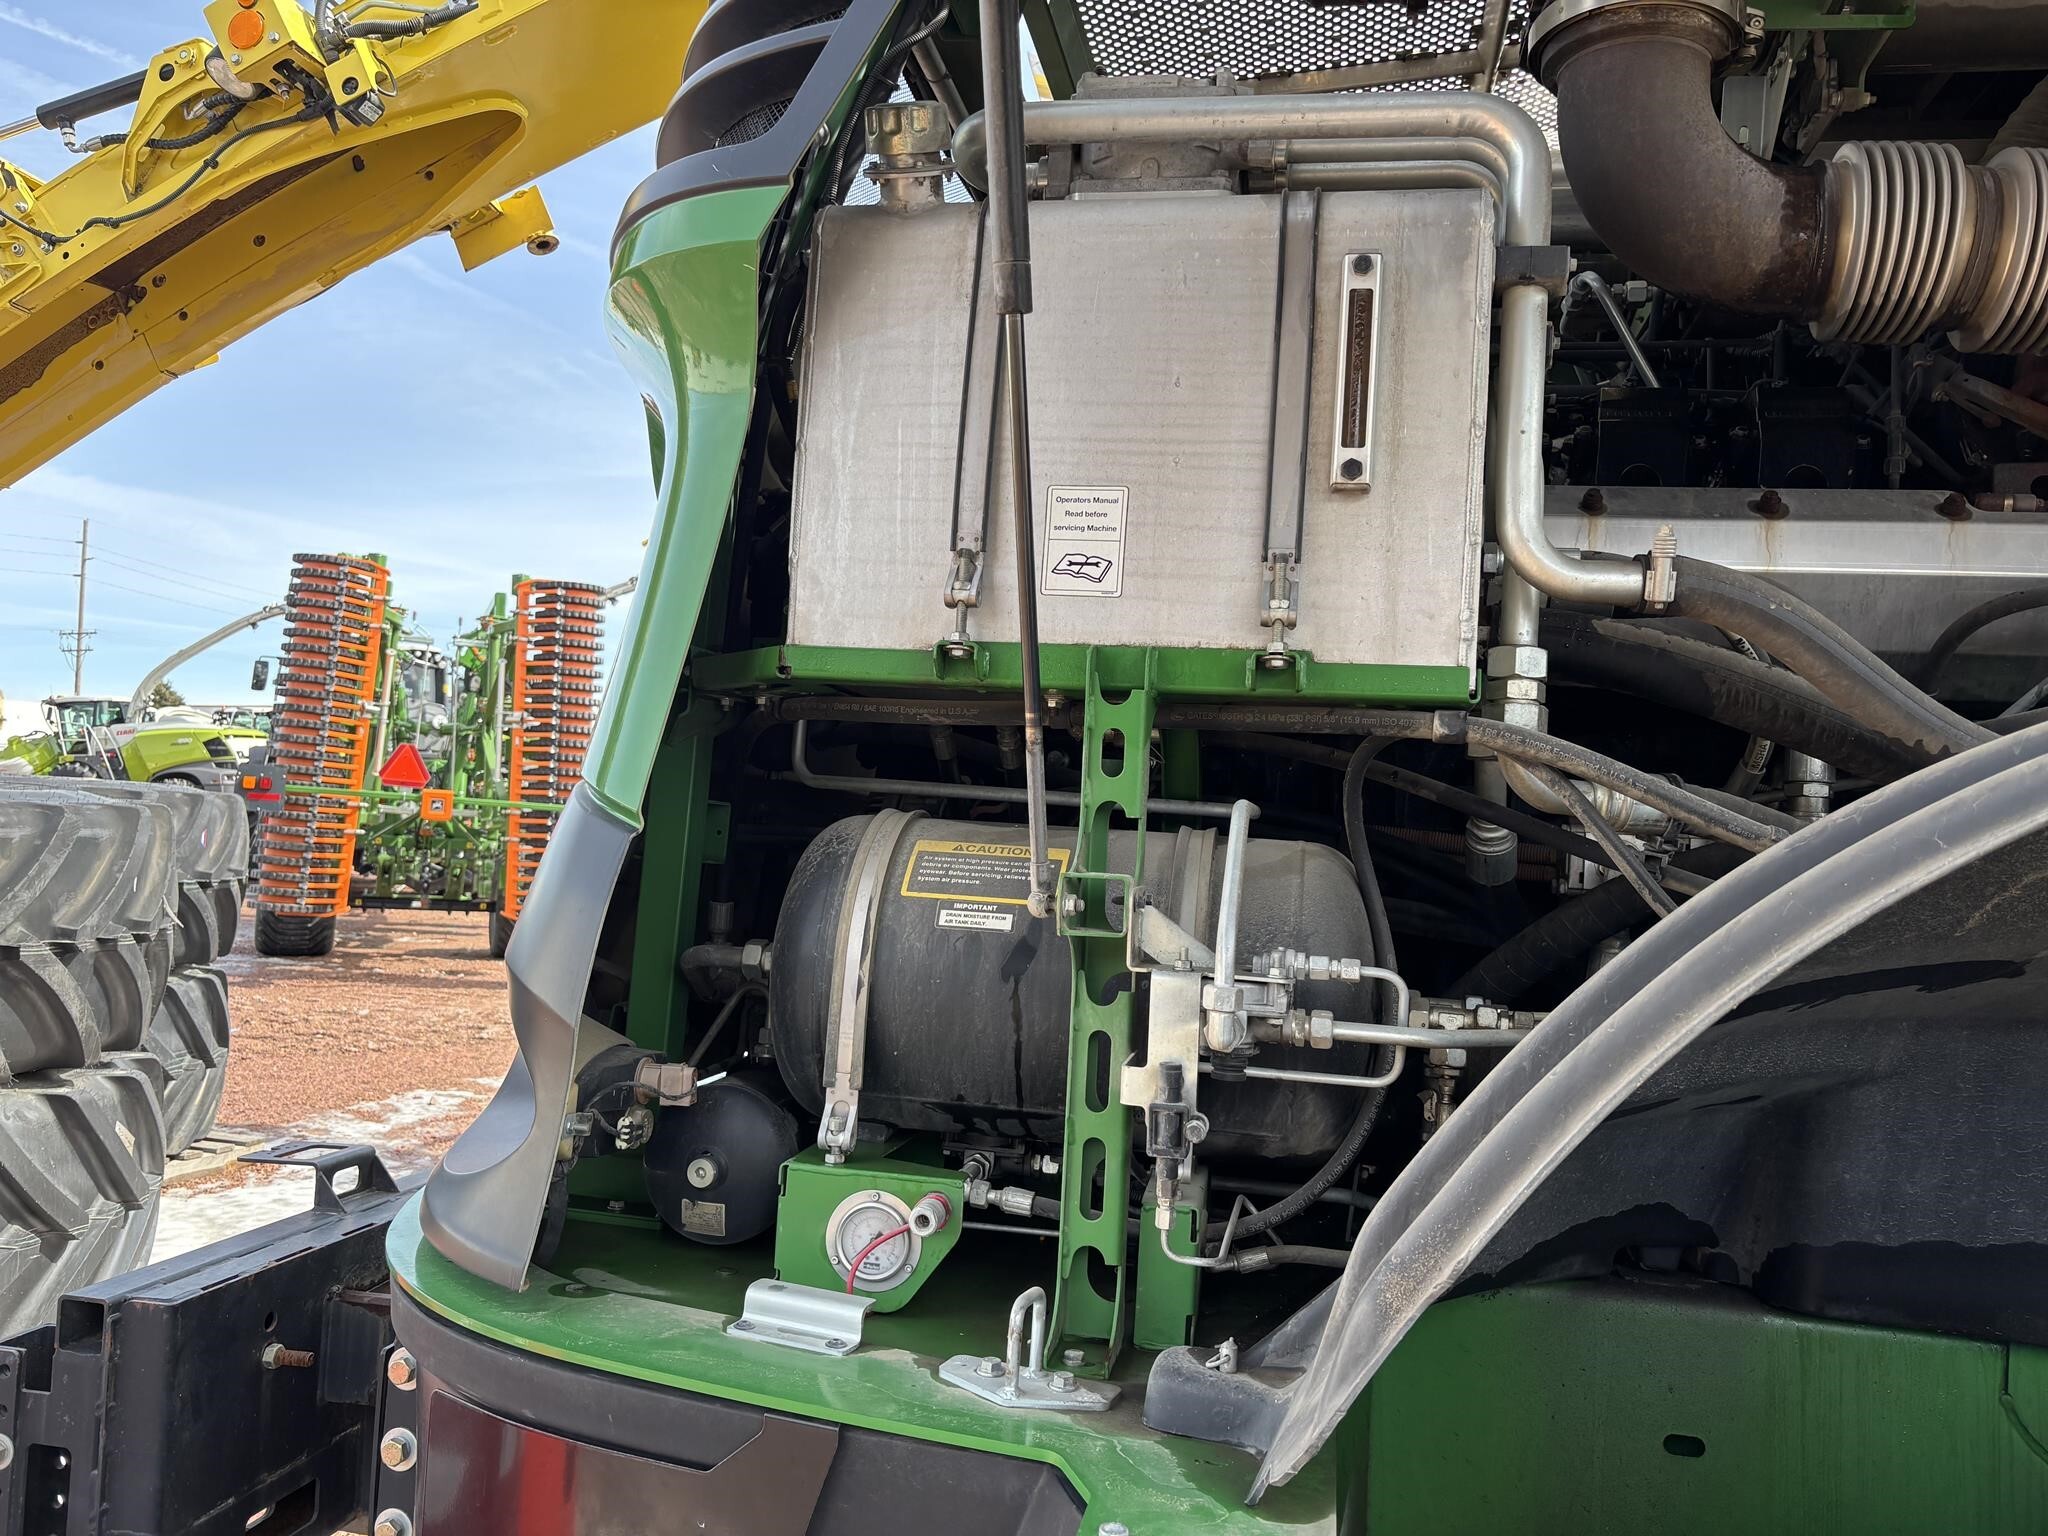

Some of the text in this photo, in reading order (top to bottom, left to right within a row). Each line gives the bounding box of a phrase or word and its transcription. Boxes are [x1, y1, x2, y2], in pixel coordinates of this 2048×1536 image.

[1056, 496, 1091, 504] Operators
[1054, 524, 1085, 532] servicing
[900, 706, 938, 715] Engineered
[1362, 717, 1380, 727] mm)
[1382, 717, 1397, 726] ISO
[1485, 728, 1498, 738] R6
[1504, 731, 1523, 745] SAE
[1525, 737, 1552, 754] 100R6
[1552, 747, 1600, 772] Engineered
[1600, 765, 1608, 775] in
[953, 902, 998, 911] IMPORTANT
[1350, 1134, 1363, 1153] mm)
[1341, 1152, 1353, 1165] ISO
[1313, 1177, 1330, 1195] Type
[1281, 1198, 1304, 1218] EN854
[1249, 1222, 1265, 1233] SAE
